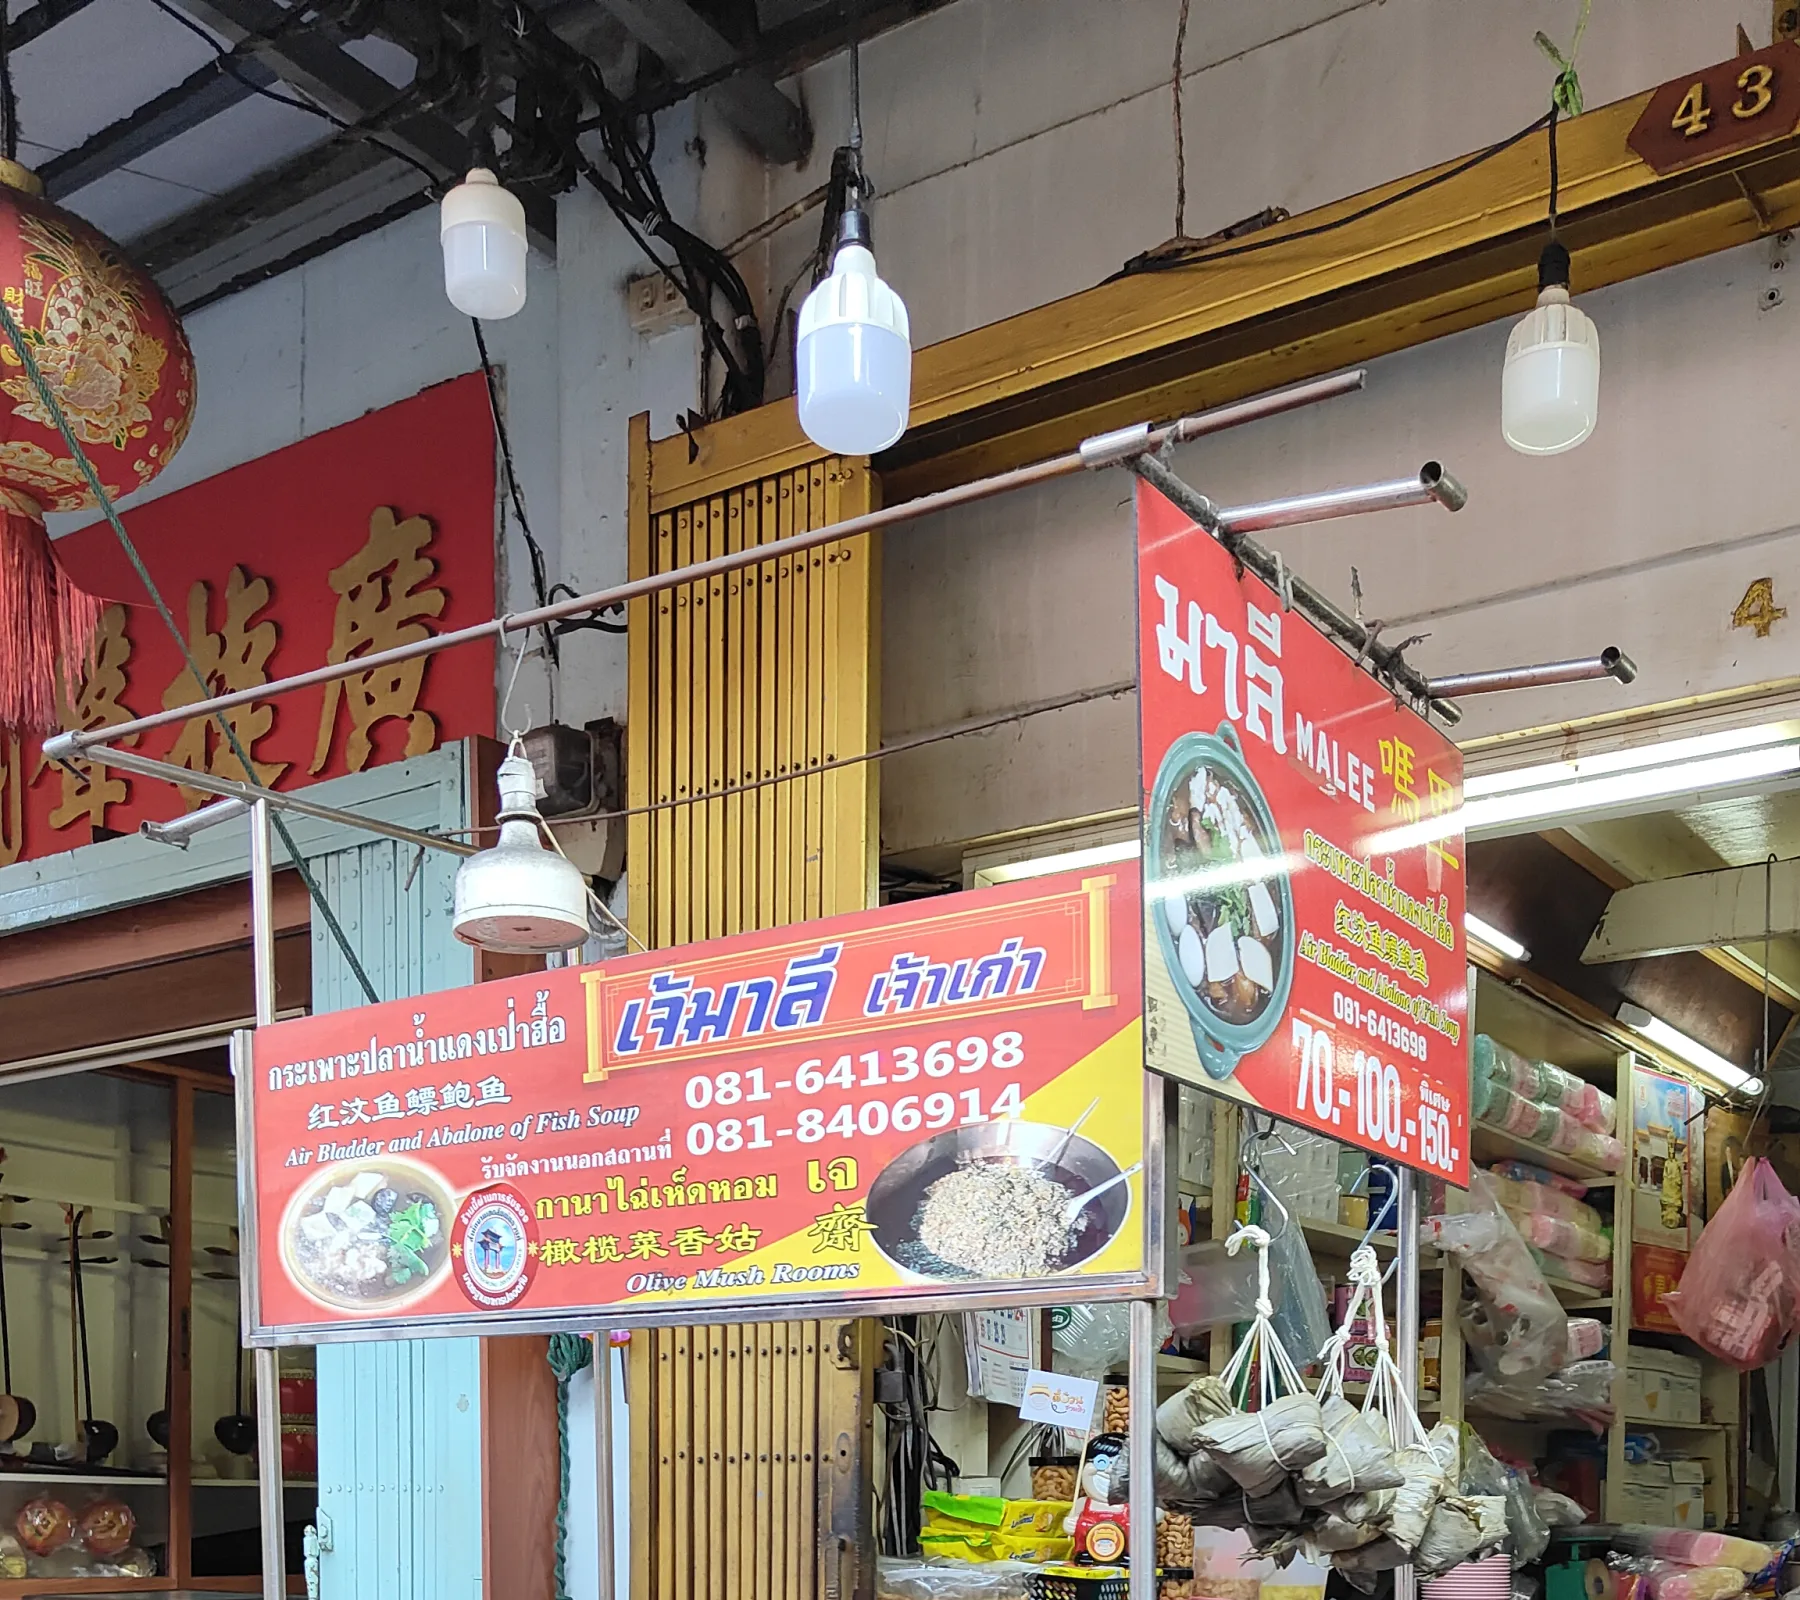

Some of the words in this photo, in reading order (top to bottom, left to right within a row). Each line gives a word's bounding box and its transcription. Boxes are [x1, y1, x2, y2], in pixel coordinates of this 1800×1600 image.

[1672, 65, 1773, 136] 43
[1154, 574, 1288, 756] มาลี
[1296, 712, 1376, 813] MALEE
[863, 936, 1047, 1017] เจ้าเก่า
[1298, 929, 1318, 963] Air
[1317, 938, 1357, 984] Bladder
[1356, 967, 1376, 995] and
[1374, 972, 1411, 1014] Abalone
[1410, 995, 1422, 1025] of
[1420, 997, 1440, 1032] Fish
[1439, 1009, 1460, 1046] Soup
[269, 990, 566, 1091] กระเพาะปลาน้ำแดงเป่าฮื้อ
[1333, 991, 1427, 1061] 081-6413698
[685, 1031, 1024, 1109] 081-6413698
[1419, 1080, 1451, 1113] พิเศษ
[285, 1147, 313, 1167] Air
[316, 1137, 385, 1163] Bladder
[388, 1129, 423, 1153] and
[426, 1122, 505, 1148] Abalone
[510, 1114, 533, 1141] of
[535, 1109, 581, 1134] Fish
[586, 1105, 640, 1128] Soup
[481, 1128, 672, 1179] รับจัดงานนอกสถานที่
[686, 1083, 1026, 1155] 081-8406914
[535, 1165, 778, 1220] กานาไฉ่เห็ดหอม
[806, 1155, 859, 1194] เจ
[626, 1273, 688, 1293] Olive
[693, 1265, 764, 1288] Mush
[770, 1262, 860, 1284] Rooms
